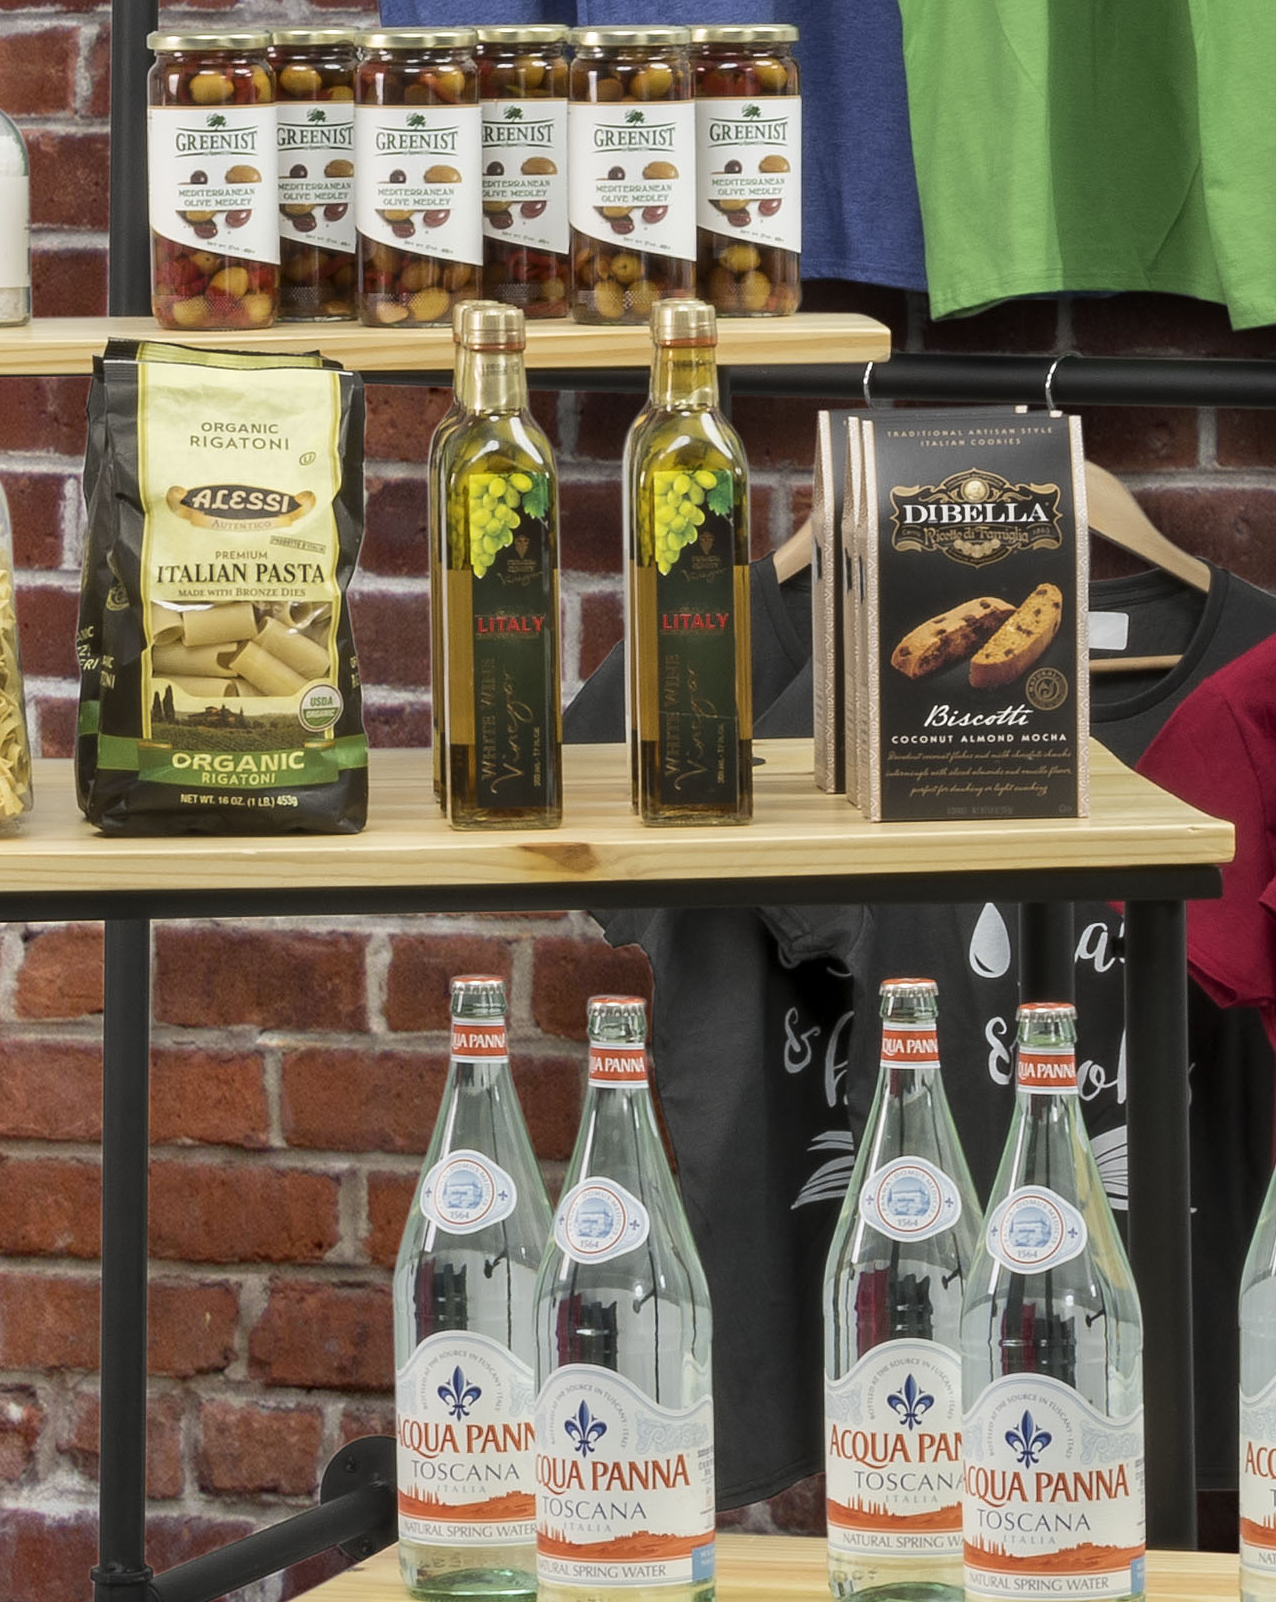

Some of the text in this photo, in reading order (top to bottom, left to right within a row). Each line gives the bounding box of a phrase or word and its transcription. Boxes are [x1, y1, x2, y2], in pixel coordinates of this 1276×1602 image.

[277, 126, 354, 146] GREENIST
[482, 123, 555, 143] REENIST
[594, 127, 676, 148] GREENIST
[708, 121, 788, 142] GREENIST
[175, 130, 257, 152] GREENIST
[376, 130, 459, 151] GREENIST
[278, 182, 352, 191] MEDITERRANEAN
[482, 180, 551, 188] EDITERRANEAN
[596, 184, 673, 193] MEDITERRANEAN
[711, 178, 785, 187] MEDITERRANEAN
[178, 189, 255, 198] MEDITERRANEAN
[283, 191, 349, 200] OLIVE MEDLEY
[378, 188, 455, 197] MEDITERRANEAN
[510, 188, 548, 197] MEDLEY
[601, 194, 669, 203] OLIVE MEDLEY
[717, 187, 783, 196] OLIVE MEDLEY
[184, 198, 253, 207] OLIVE MEDLEY
[383, 198, 451, 206] OLIVE MEDLEY
[201, 422, 279, 434] ORGANIC
[887, 427, 1053, 438] TRADITIONAL ARTISAN STYLE
[190, 435, 290, 450] RIGATONI
[920, 438, 1021, 447] ITALIAN COOKIES
[191, 489, 290, 513] ALESSI
[215, 551, 268, 560] PREMIUM
[157, 563, 326, 584] ITALIAN PASTA
[477, 616, 545, 633] LITALY
[662, 613, 730, 630] LITALY
[310, 696, 333, 707] USDA
[923, 703, 1034, 727] Biscotti
[891, 733, 1067, 744] COCONUT ALMOND MOCHA
[172, 751, 305, 772] ORGANIC
[202, 772, 276, 786] RIGATONI
[180, 794, 199, 804] NET
[276, 795, 299, 807] 453g
[829, 1424, 911, 1469] ACQUA
[411, 1460, 520, 1482] TOSCANA
[591, 1453, 691, 1491] PANNA
[437, 1485, 487, 1494] ITALIA
[1035, 1464, 1130, 1503] PANNA
[886, 1495, 938, 1503] ITALIA
[541, 1496, 647, 1520] TOSCANA
[977, 1508, 1091, 1532] TOSCANA
[447, 1524, 493, 1538] SPRING
[563, 1523, 612, 1533] ITALIA
[842, 1532, 944, 1548] NATURAL SPRING
[1003, 1534, 1056, 1545] ITALIA
[573, 1563, 666, 1578] SPRING WATER
[1014, 1576, 1063, 1591] SPRING
[1067, 1576, 1109, 1590] WATER
